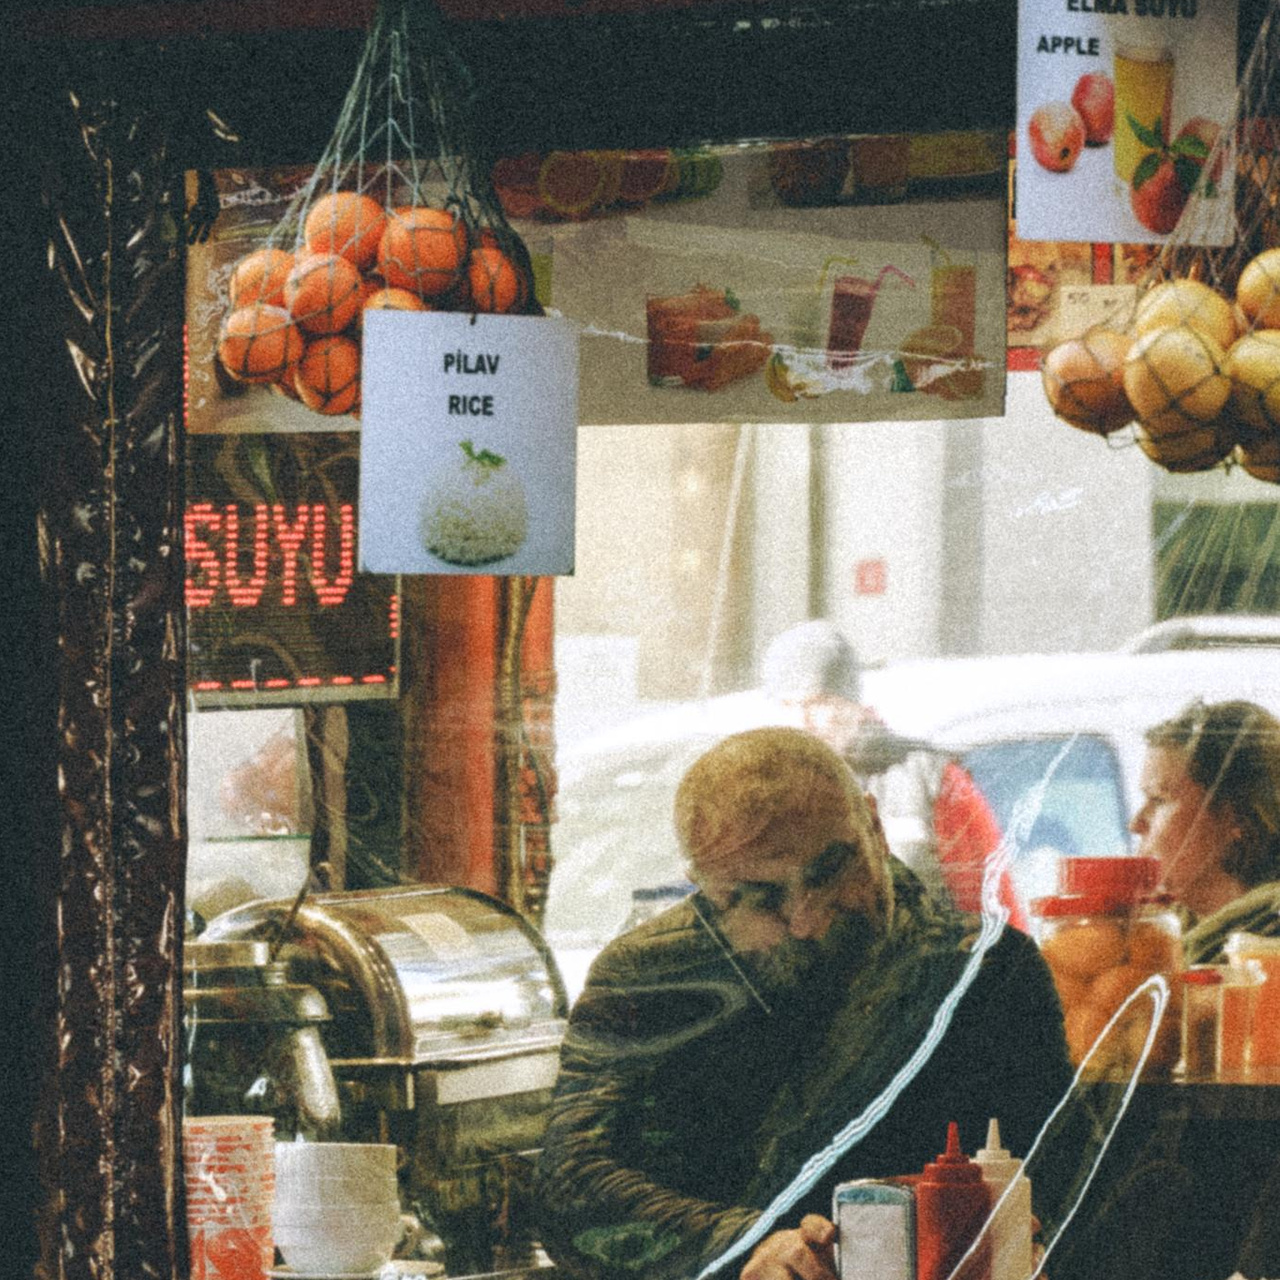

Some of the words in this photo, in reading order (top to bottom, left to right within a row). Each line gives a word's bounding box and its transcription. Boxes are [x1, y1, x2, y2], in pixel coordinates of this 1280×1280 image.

[1036, 35, 1100, 56] APPLE
[443, 348, 500, 375] PİLAV
[448, 394, 495, 416] RICE
[184, 503, 353, 606] SUYU
